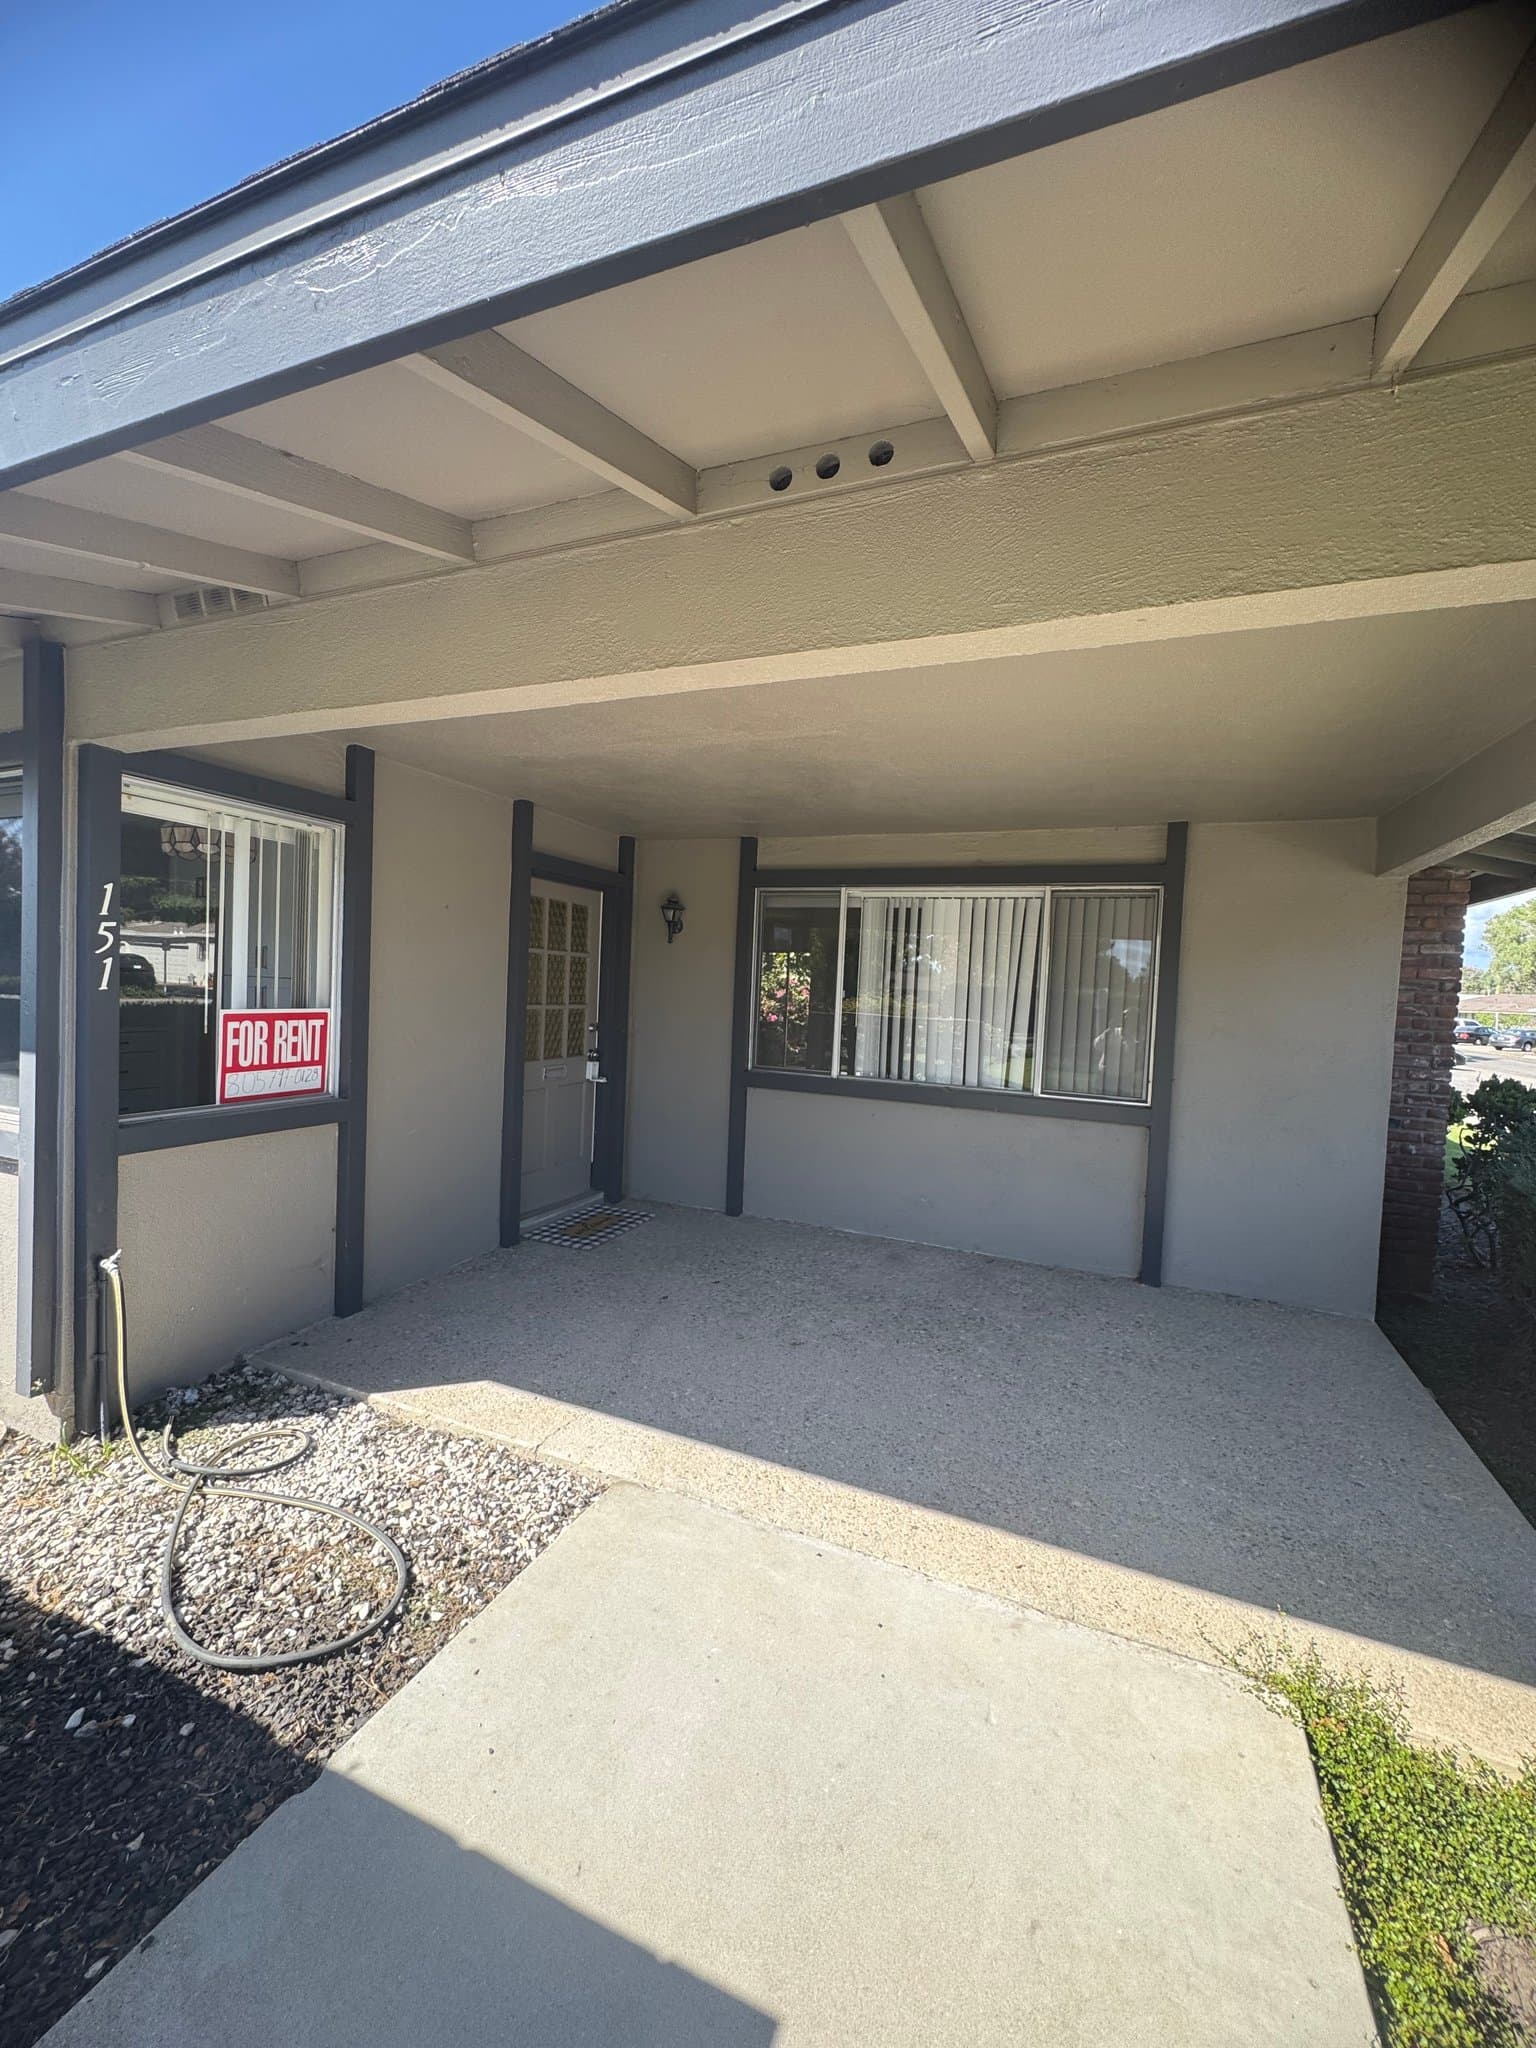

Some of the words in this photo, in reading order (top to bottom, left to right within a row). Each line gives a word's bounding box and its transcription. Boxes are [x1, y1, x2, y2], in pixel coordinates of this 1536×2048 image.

[95, 883, 117, 990] 151
[225, 1020, 269, 1068] FOR
[273, 1019, 325, 1064] RENT
